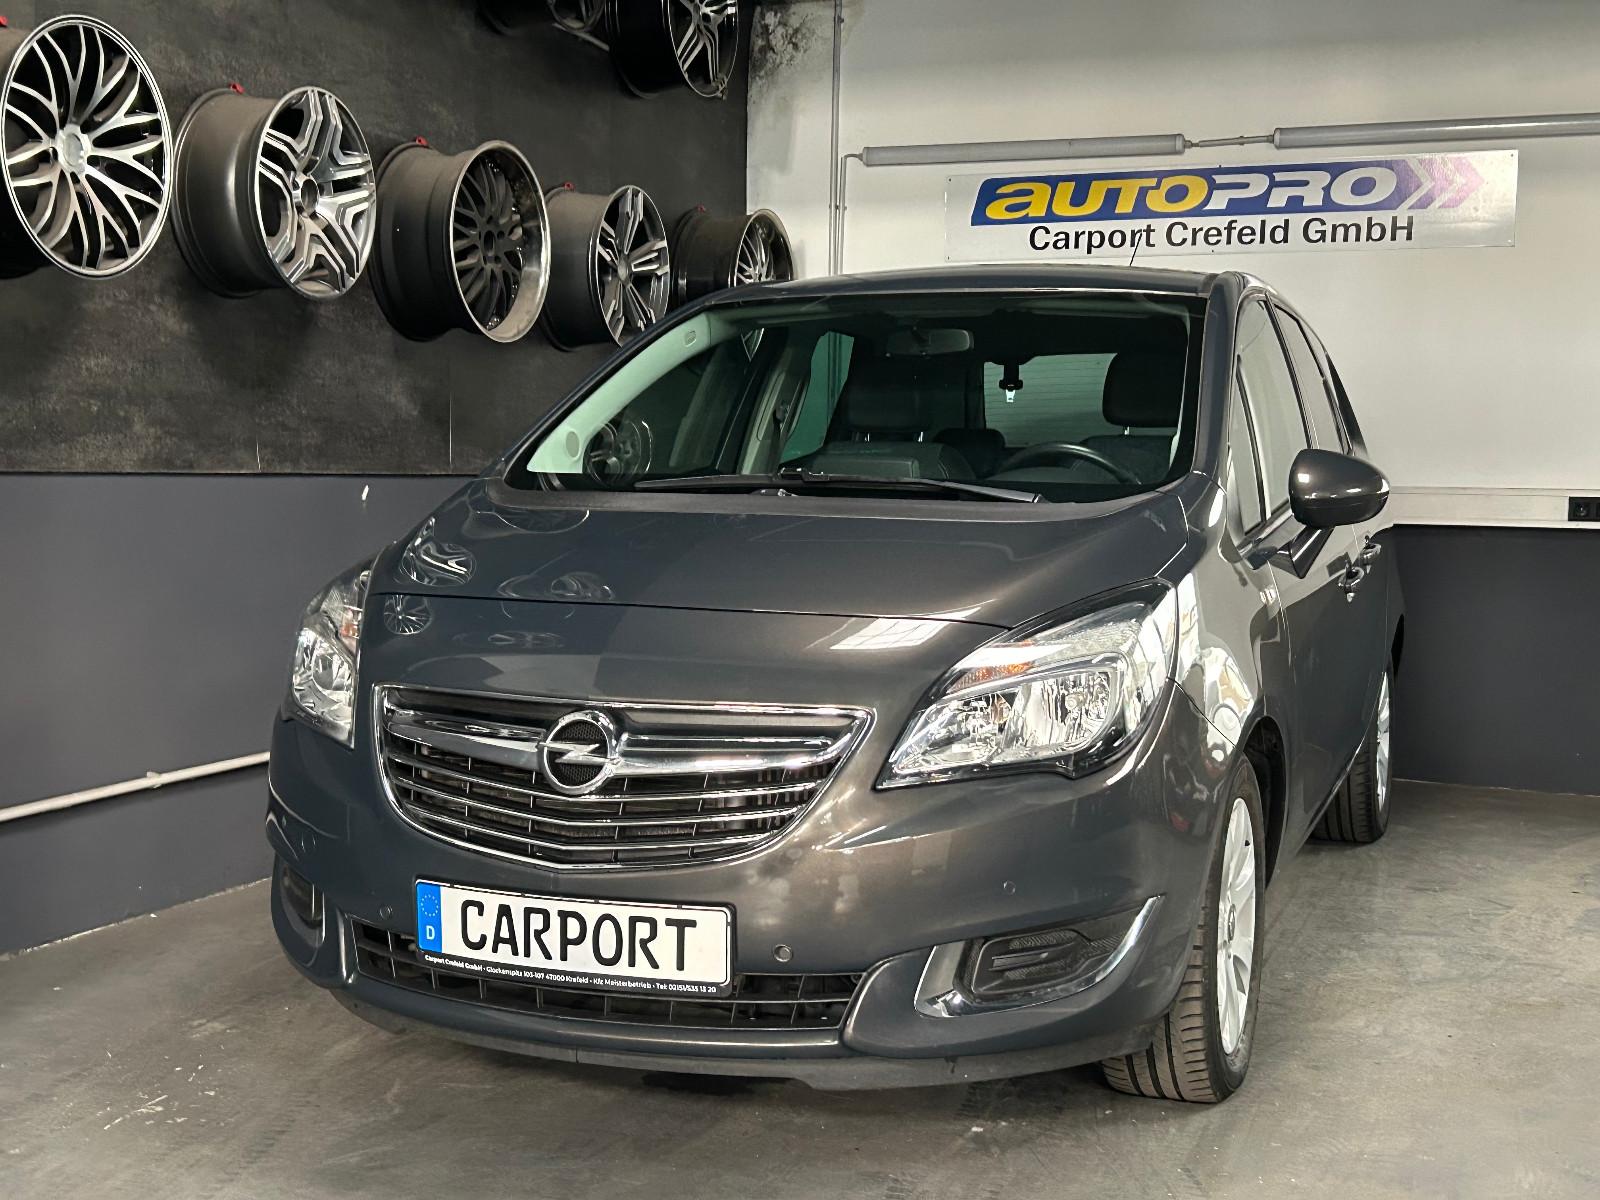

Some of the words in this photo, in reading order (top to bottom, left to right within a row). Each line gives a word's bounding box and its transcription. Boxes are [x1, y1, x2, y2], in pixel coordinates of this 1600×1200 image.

[1029, 223, 1156, 255] Carport
[1165, 218, 1290, 248] Crefeld
[1303, 215, 1414, 243] GmbH
[425, 924, 435, 940] D
[460, 899, 697, 972] CARPORT
